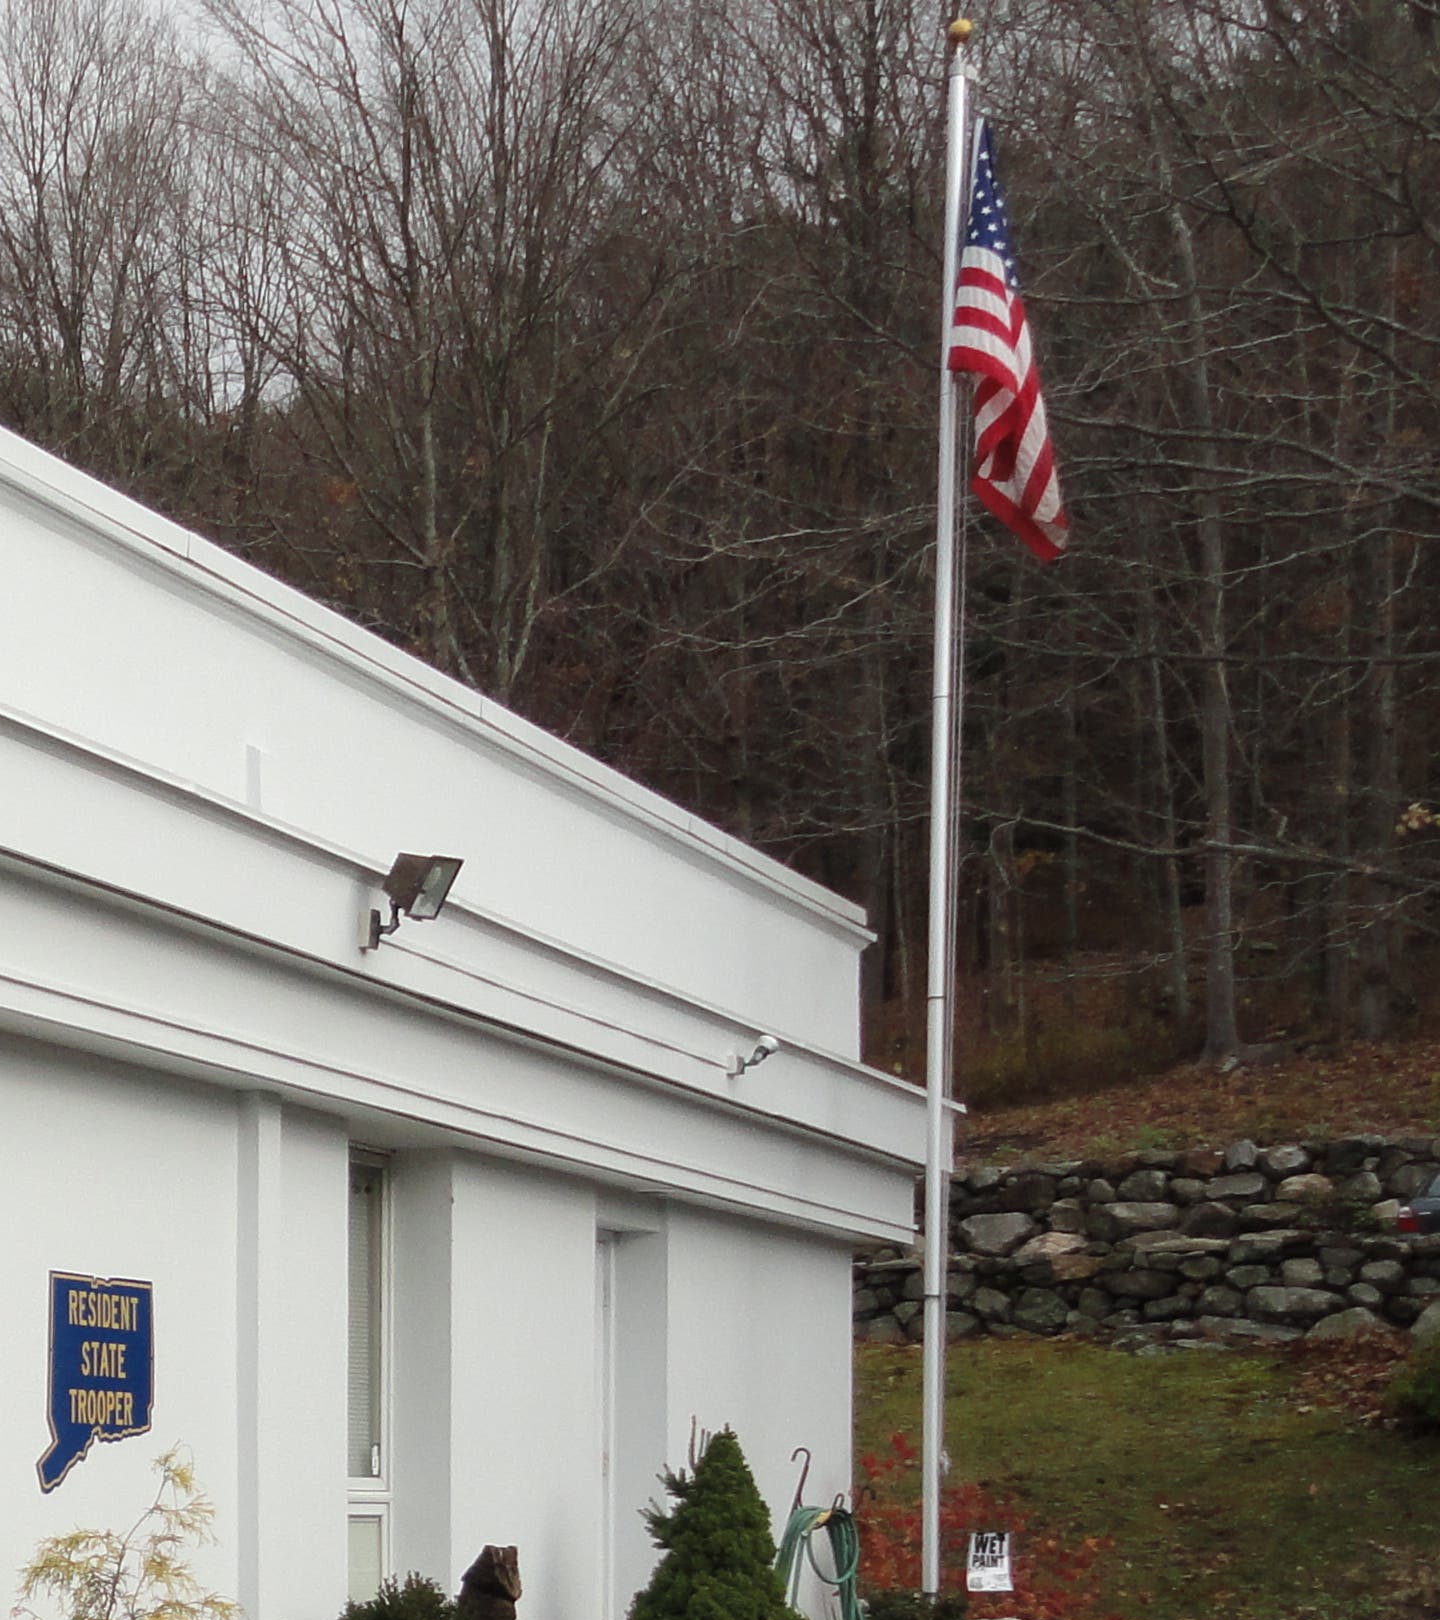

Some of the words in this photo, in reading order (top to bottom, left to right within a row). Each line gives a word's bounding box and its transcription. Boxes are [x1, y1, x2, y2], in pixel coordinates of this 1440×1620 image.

[68, 1289, 139, 1332] RESIDENT
[81, 1341, 127, 1379] STATE
[69, 1389, 133, 1426] TROOPER
[972, 1555, 1005, 1569] PAINT
[974, 1534, 1006, 1554] WET
